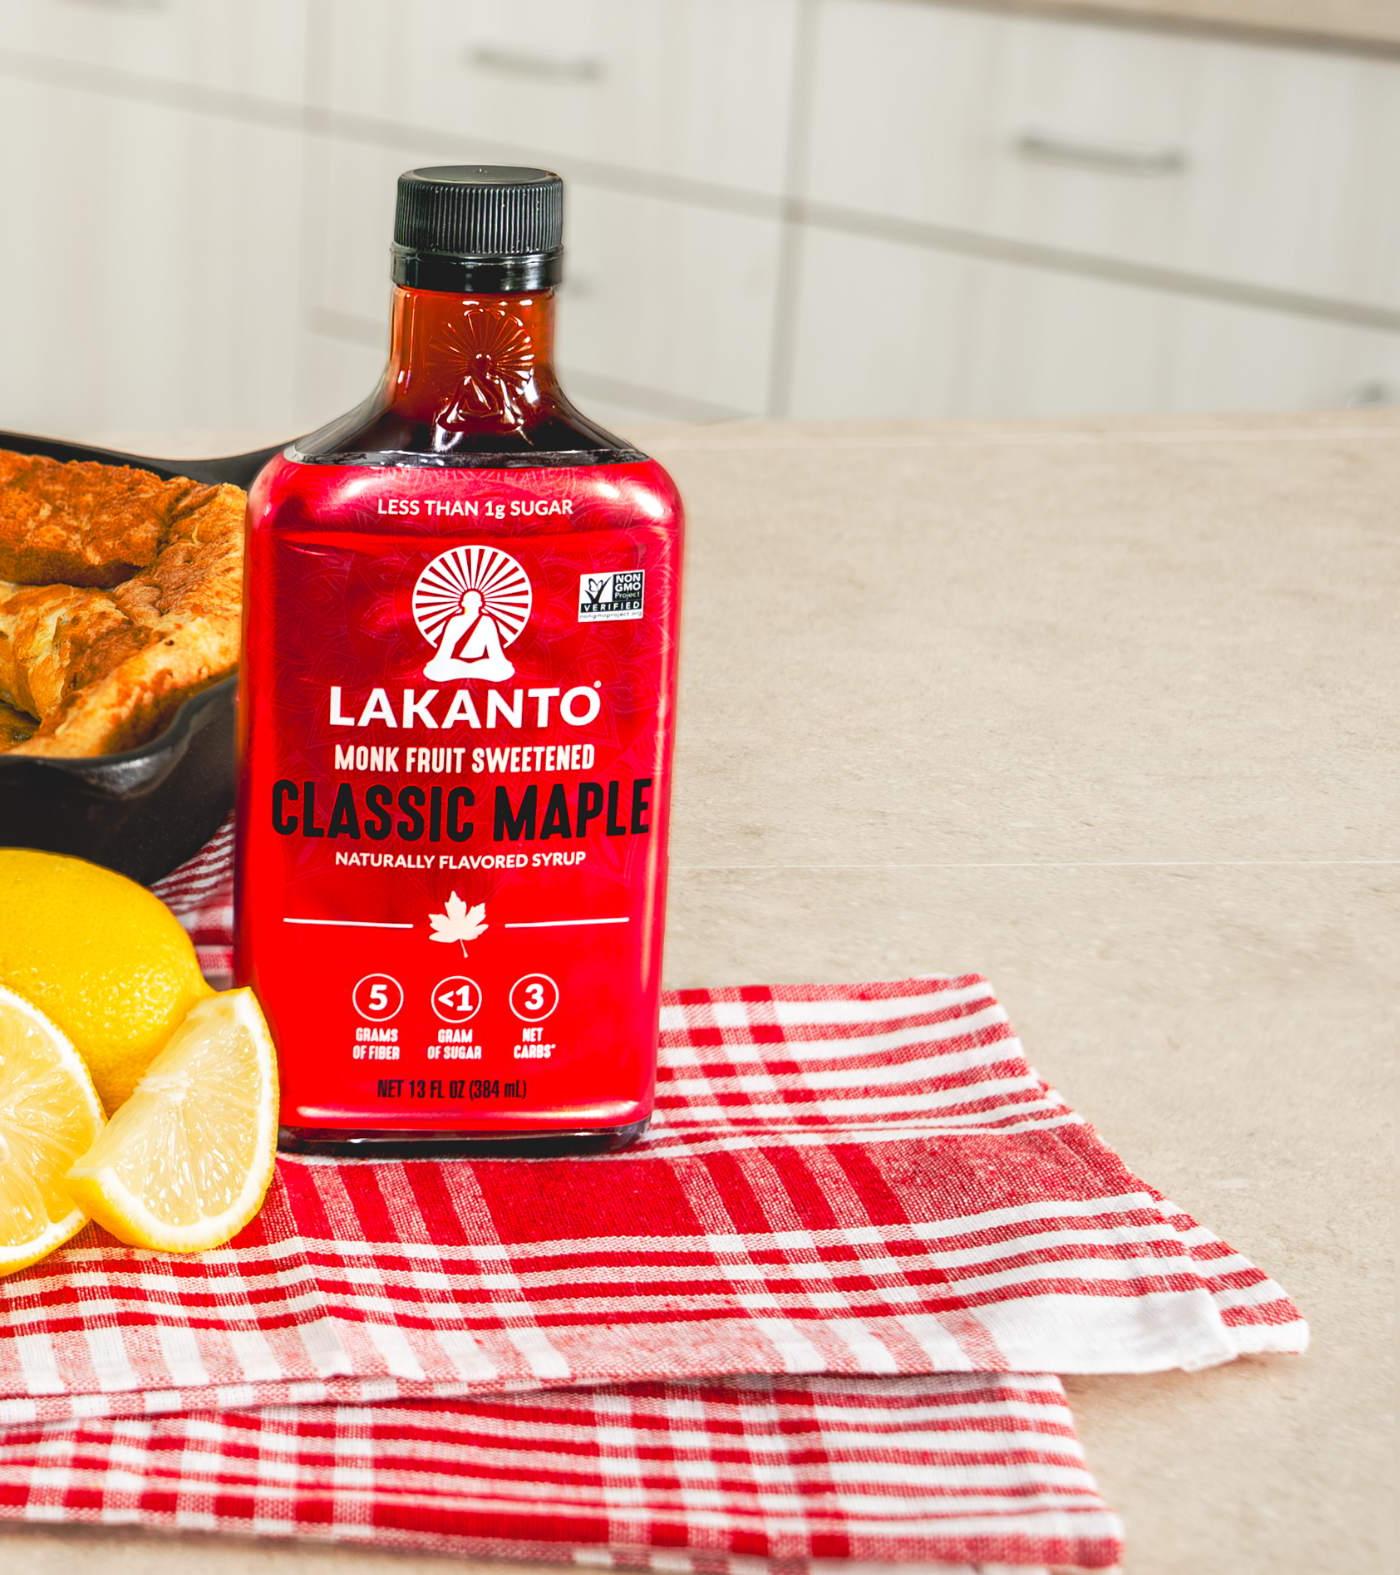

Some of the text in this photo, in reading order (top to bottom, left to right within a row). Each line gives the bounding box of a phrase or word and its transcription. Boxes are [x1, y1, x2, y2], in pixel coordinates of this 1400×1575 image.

[377, 499, 574, 520] LESS THAN 1g SUGAR
[615, 582, 641, 592] GMO
[616, 573, 641, 583] NON
[615, 592, 640, 600] Project
[584, 601, 640, 612] VERIFIED
[329, 686, 601, 729] LAKANTO
[334, 743, 595, 774] MONK FRUIT SWEETENED
[272, 778, 652, 843] CLASSIC MAPLE
[335, 850, 587, 870] NATURALLY FLAVORED SYRUP
[368, 984, 388, 1011] 5
[438, 985, 473, 1012] <1
[524, 983, 544, 1011] 3
[355, 1027, 399, 1043] GRAMS
[437, 1028, 473, 1044] GRAM
[522, 1027, 544, 1043] NET
[352, 1044, 401, 1061] OF FIBER
[427, 1045, 482, 1060] OF SUGAR
[377, 1079, 527, 1101] NET 13 FL OZ (384 mL)
